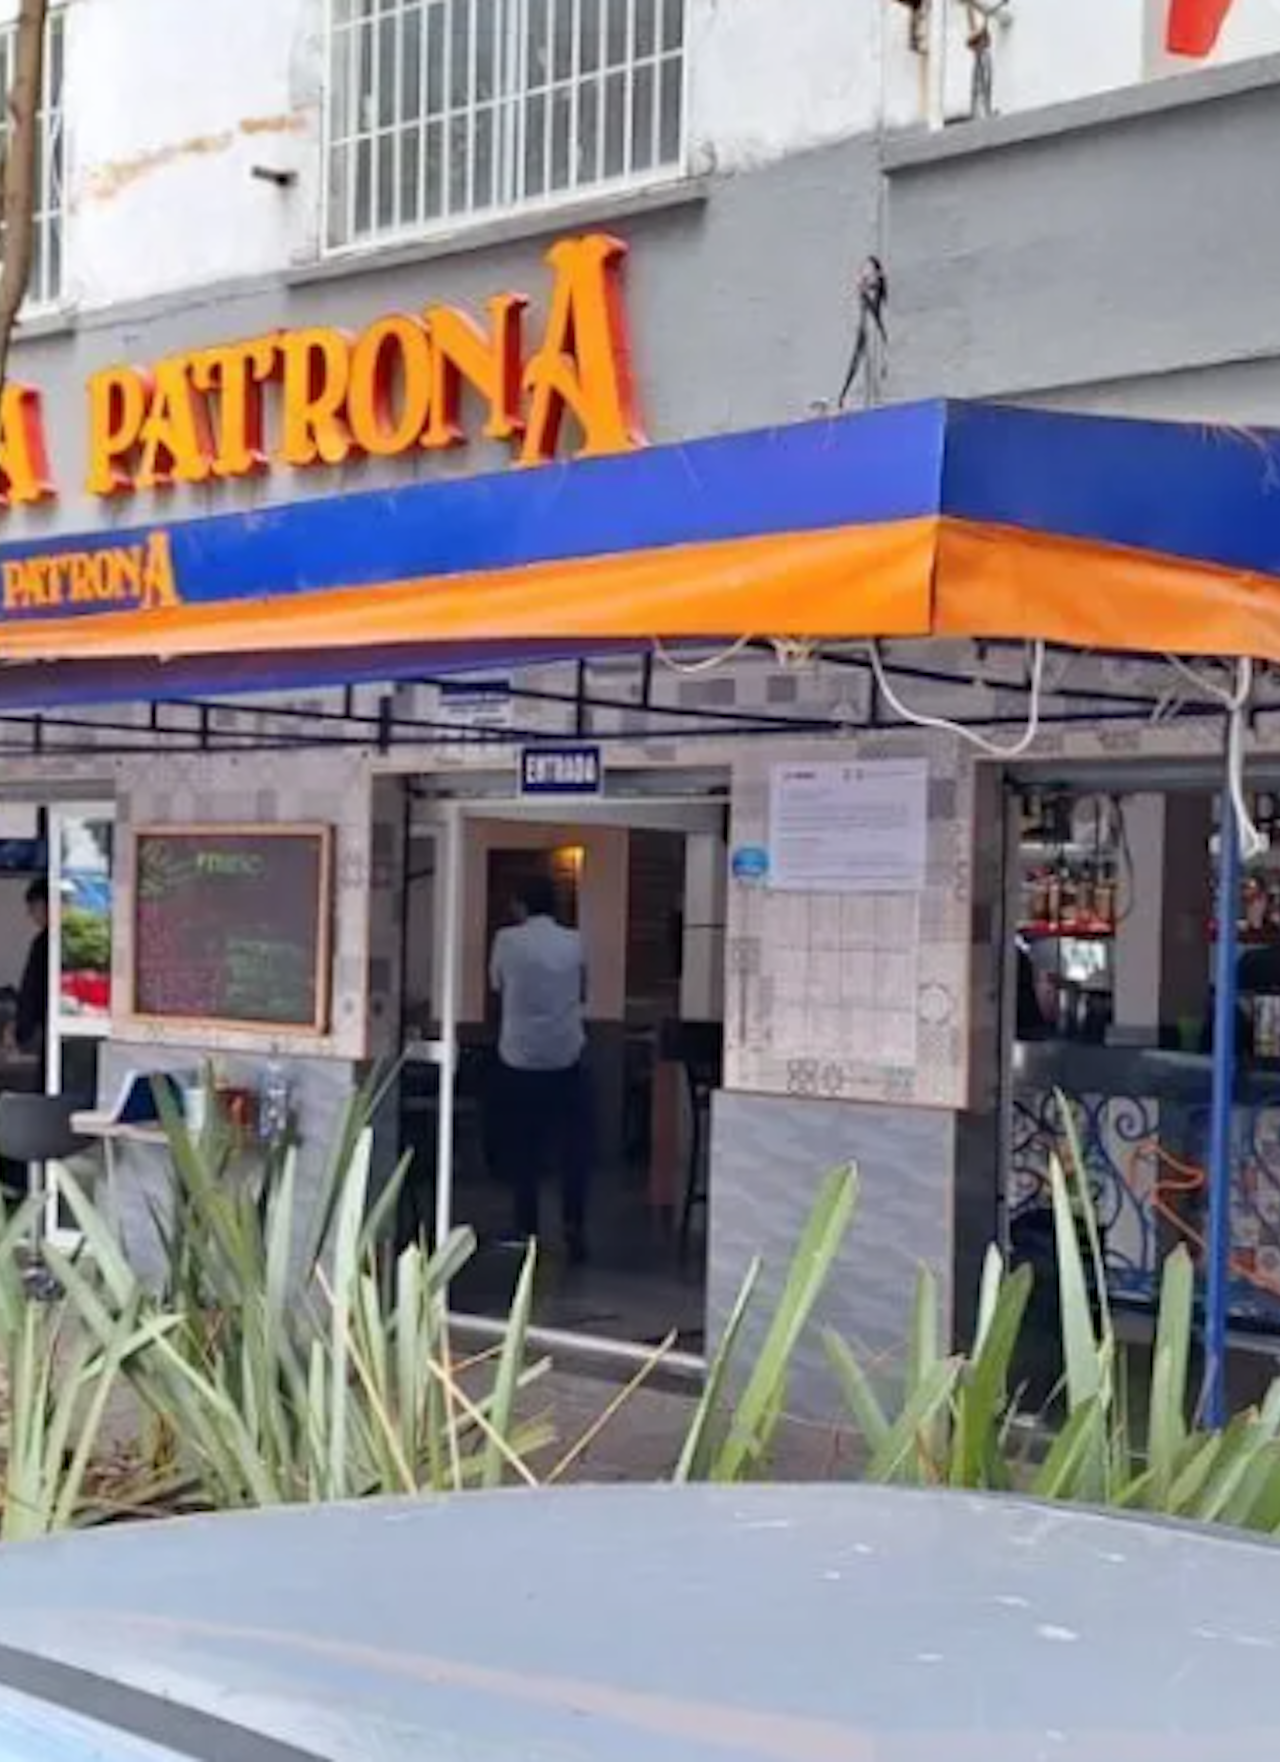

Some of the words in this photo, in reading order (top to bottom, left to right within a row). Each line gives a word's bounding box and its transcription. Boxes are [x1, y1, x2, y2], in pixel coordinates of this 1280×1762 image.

[86, 230, 650, 496] PATRONA
[1, 529, 180, 609] PATRONA
[526, 753, 596, 785] ENTRADA
